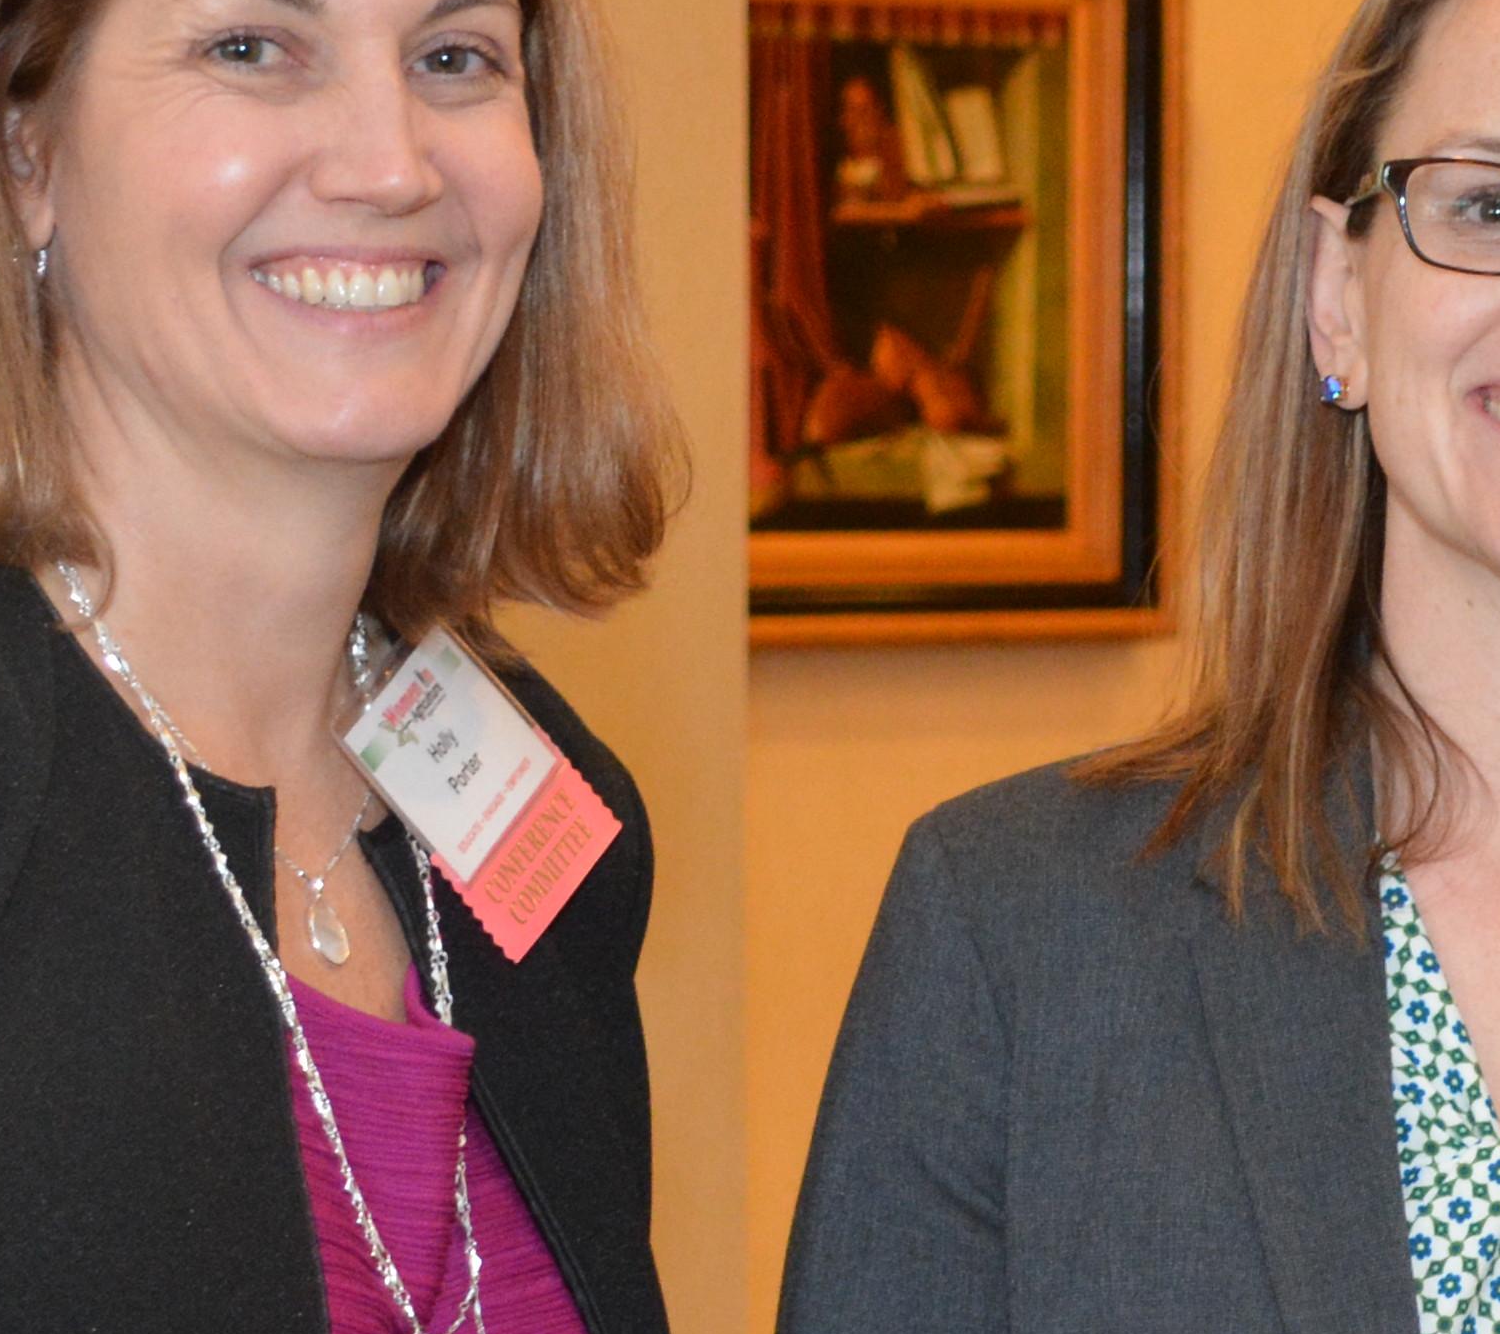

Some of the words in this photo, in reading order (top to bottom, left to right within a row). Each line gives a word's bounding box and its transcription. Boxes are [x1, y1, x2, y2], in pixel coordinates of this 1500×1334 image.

[426, 728, 459, 763] Holly
[447, 753, 483, 794] Porter
[484, 788, 575, 904] CONFERENCE
[510, 815, 593, 924] COMMITTEE
